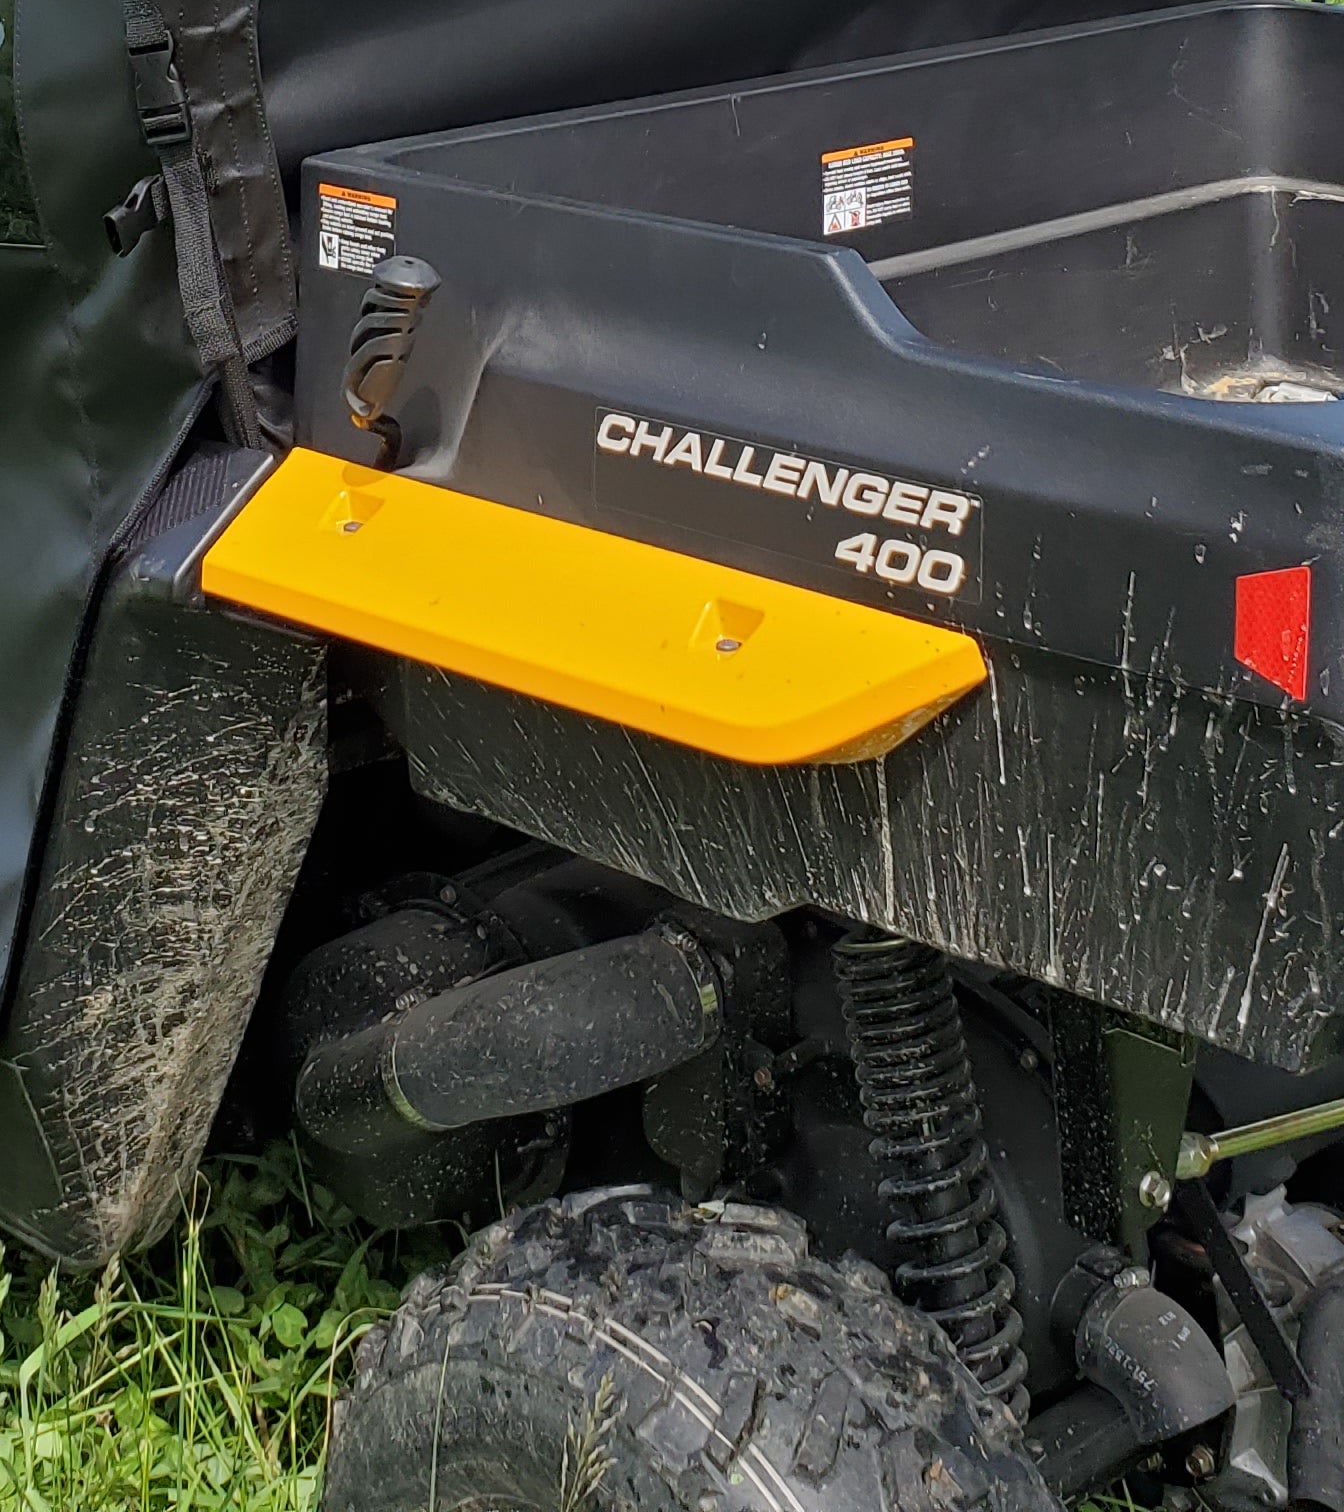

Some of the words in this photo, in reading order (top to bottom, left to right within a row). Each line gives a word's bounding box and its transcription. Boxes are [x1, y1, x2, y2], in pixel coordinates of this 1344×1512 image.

[860, 146, 884, 155] WARNING
[348, 192, 372, 201] WARNING
[596, 413, 970, 535] CHALLENGER
[834, 532, 966, 594] 400
